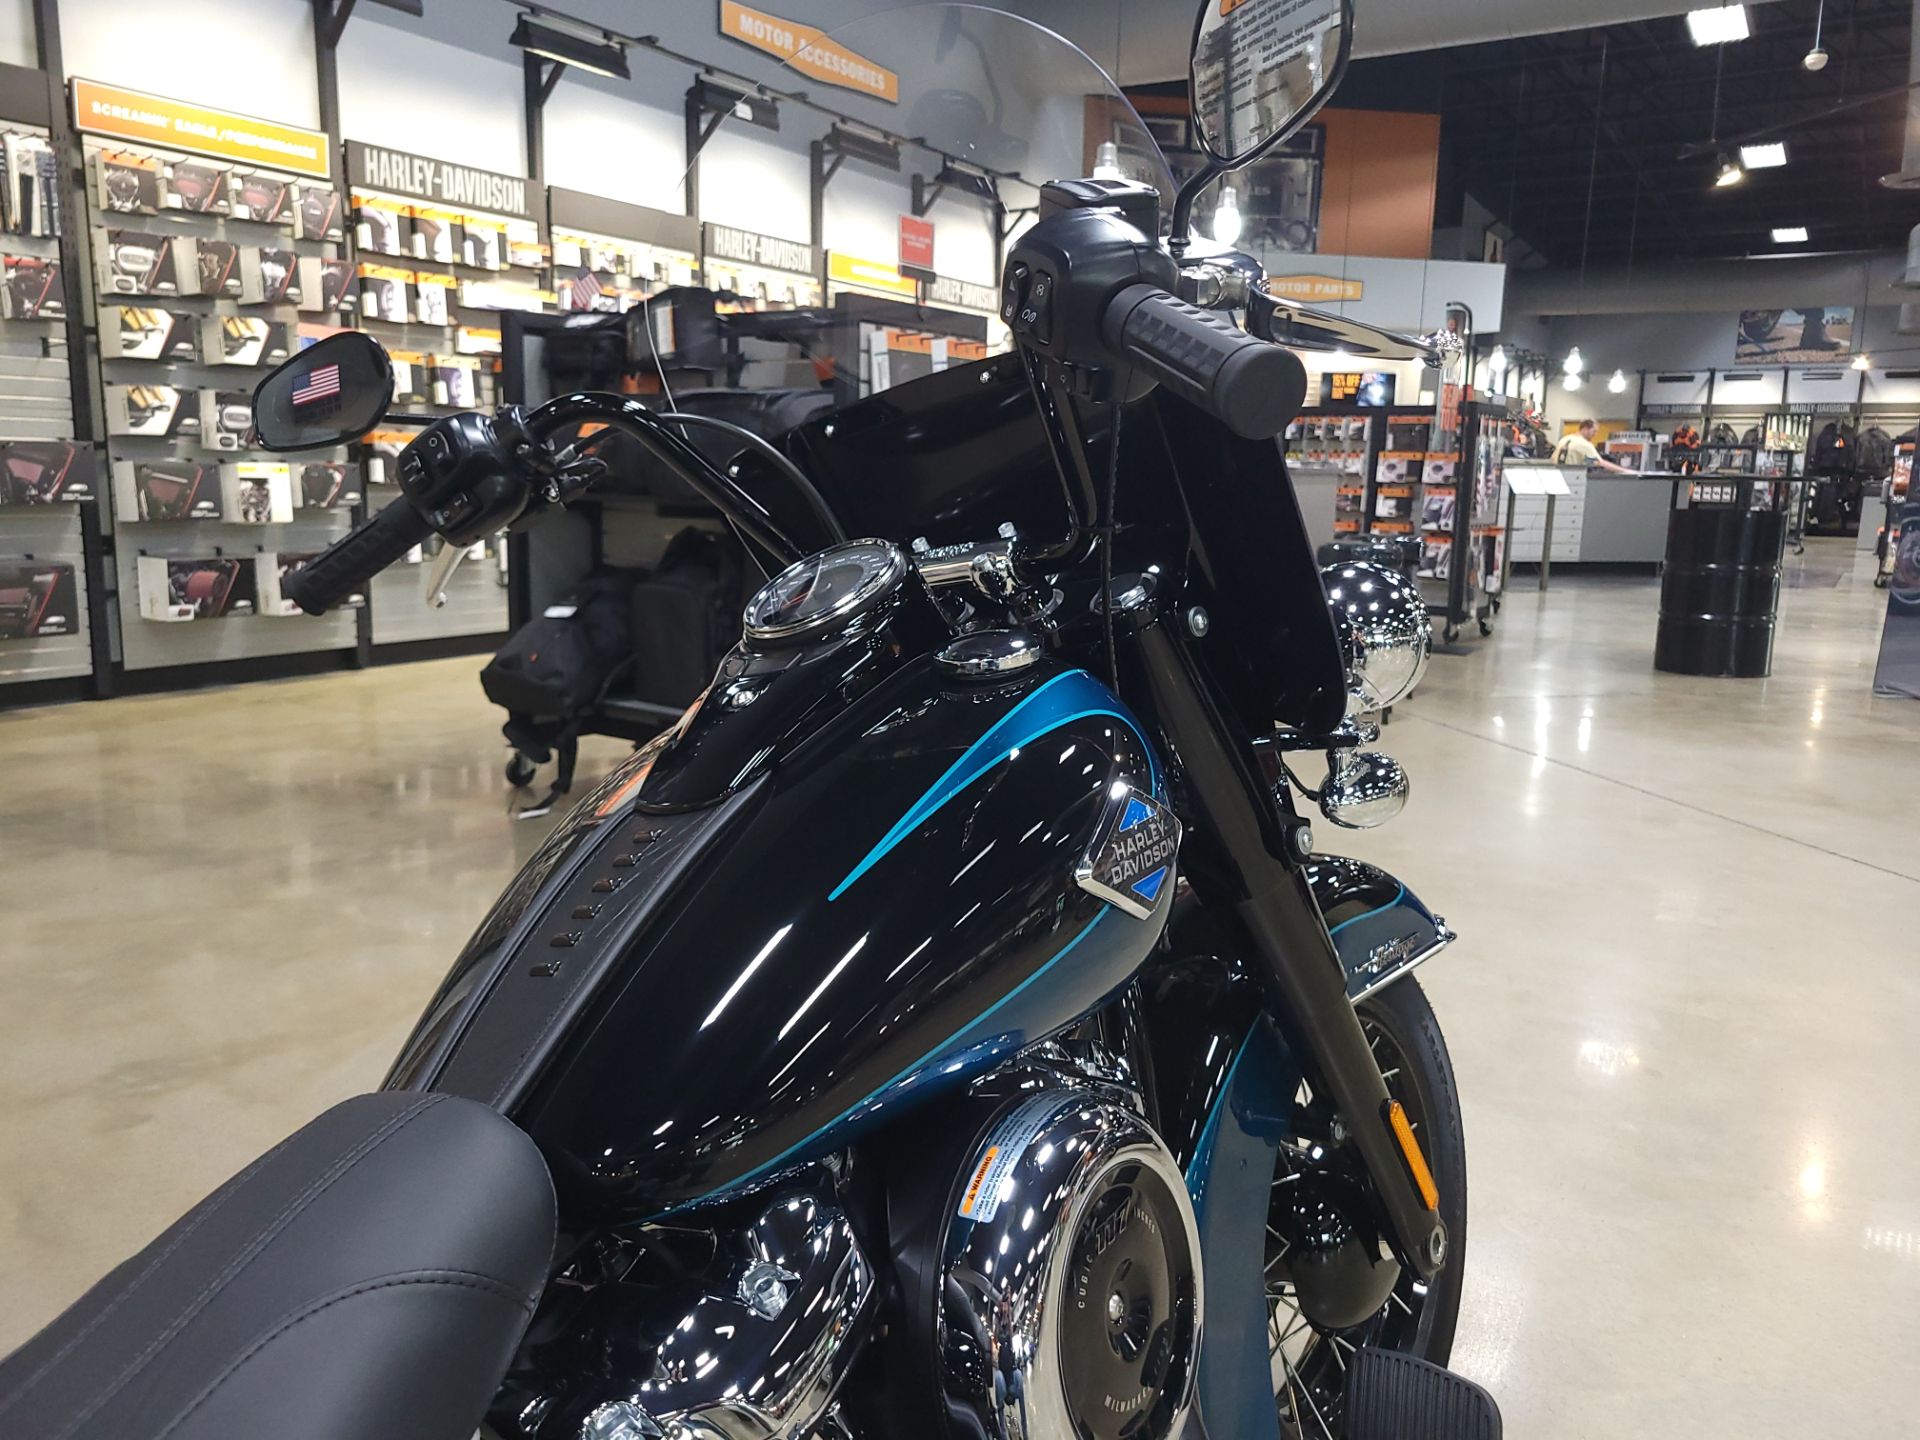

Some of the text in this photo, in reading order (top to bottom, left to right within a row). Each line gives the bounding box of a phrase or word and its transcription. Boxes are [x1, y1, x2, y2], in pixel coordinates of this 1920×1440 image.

[739, 13, 886, 91] MOTOR ACCESSORIES
[174, 118, 217, 139] EAGLE
[364, 147, 527, 216] HARLEY-DAVIDSON
[713, 225, 812, 275] HARLEY-DAVIDSON
[1314, 282, 1354, 297] PARTS
[1346, 373, 1361, 387] OFF
[1110, 835, 1176, 886] DAVIDSON
[970, 1156, 993, 1192] WARNING
[1077, 1253, 1094, 1309] CUBIC
